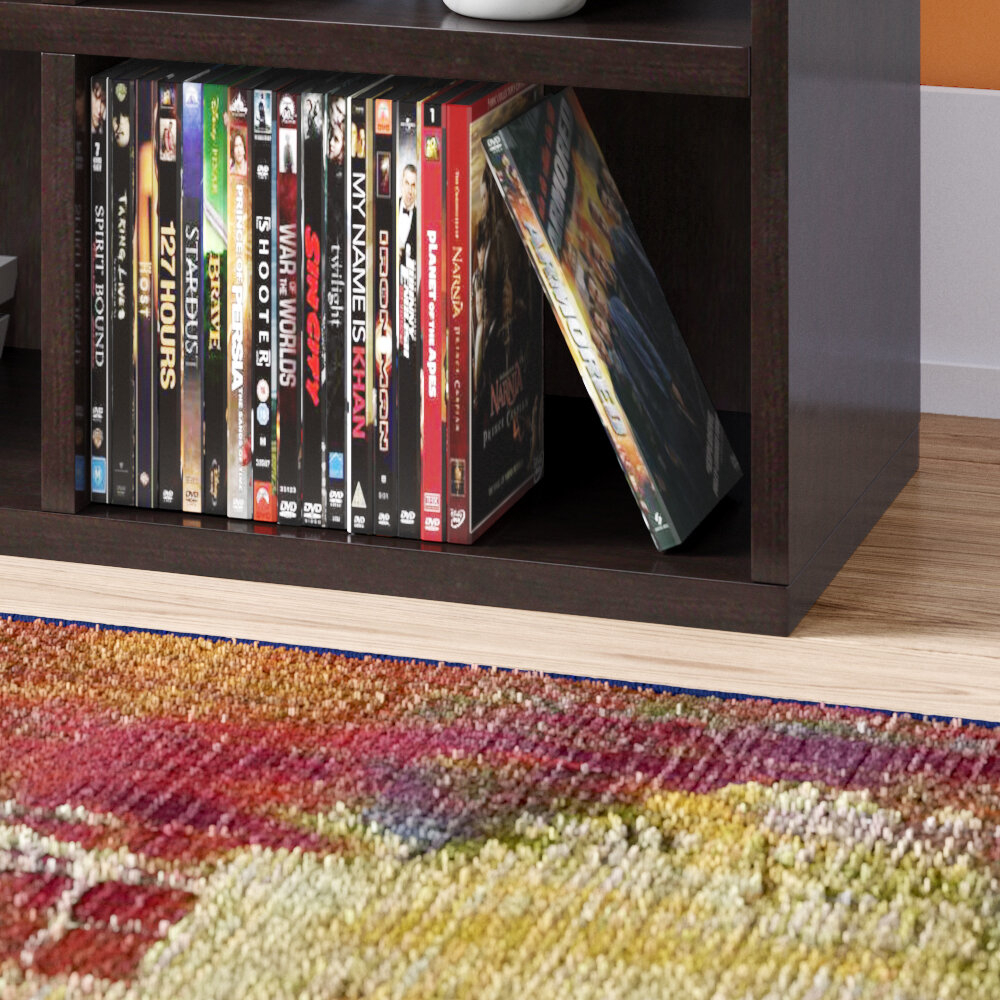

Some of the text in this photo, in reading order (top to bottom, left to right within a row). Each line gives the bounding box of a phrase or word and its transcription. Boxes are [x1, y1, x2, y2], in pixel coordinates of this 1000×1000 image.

[235, 184, 244, 253] PRINCE
[279, 224, 296, 273] WAR
[94, 205, 104, 367] SPIRIT BOUND
[160, 220, 176, 390] 127 HOURS
[184, 225, 199, 368] STARDUST
[208, 253, 221, 350] BRAVE
[236, 257, 244, 284] OF
[256, 218, 270, 366] SHOOTER
[279, 278, 288, 296] THE
[305, 225, 320, 406] SIN CITY
[327, 244, 346, 328] twilight
[352, 172, 366, 439] MY NAME IS KHAN
[429, 302, 434, 320] OF
[451, 246, 463, 318] NARNIA
[231, 285, 244, 391] PERSIA
[279, 299, 296, 387] WORLDS
[522, 219, 627, 437] ARMORED
